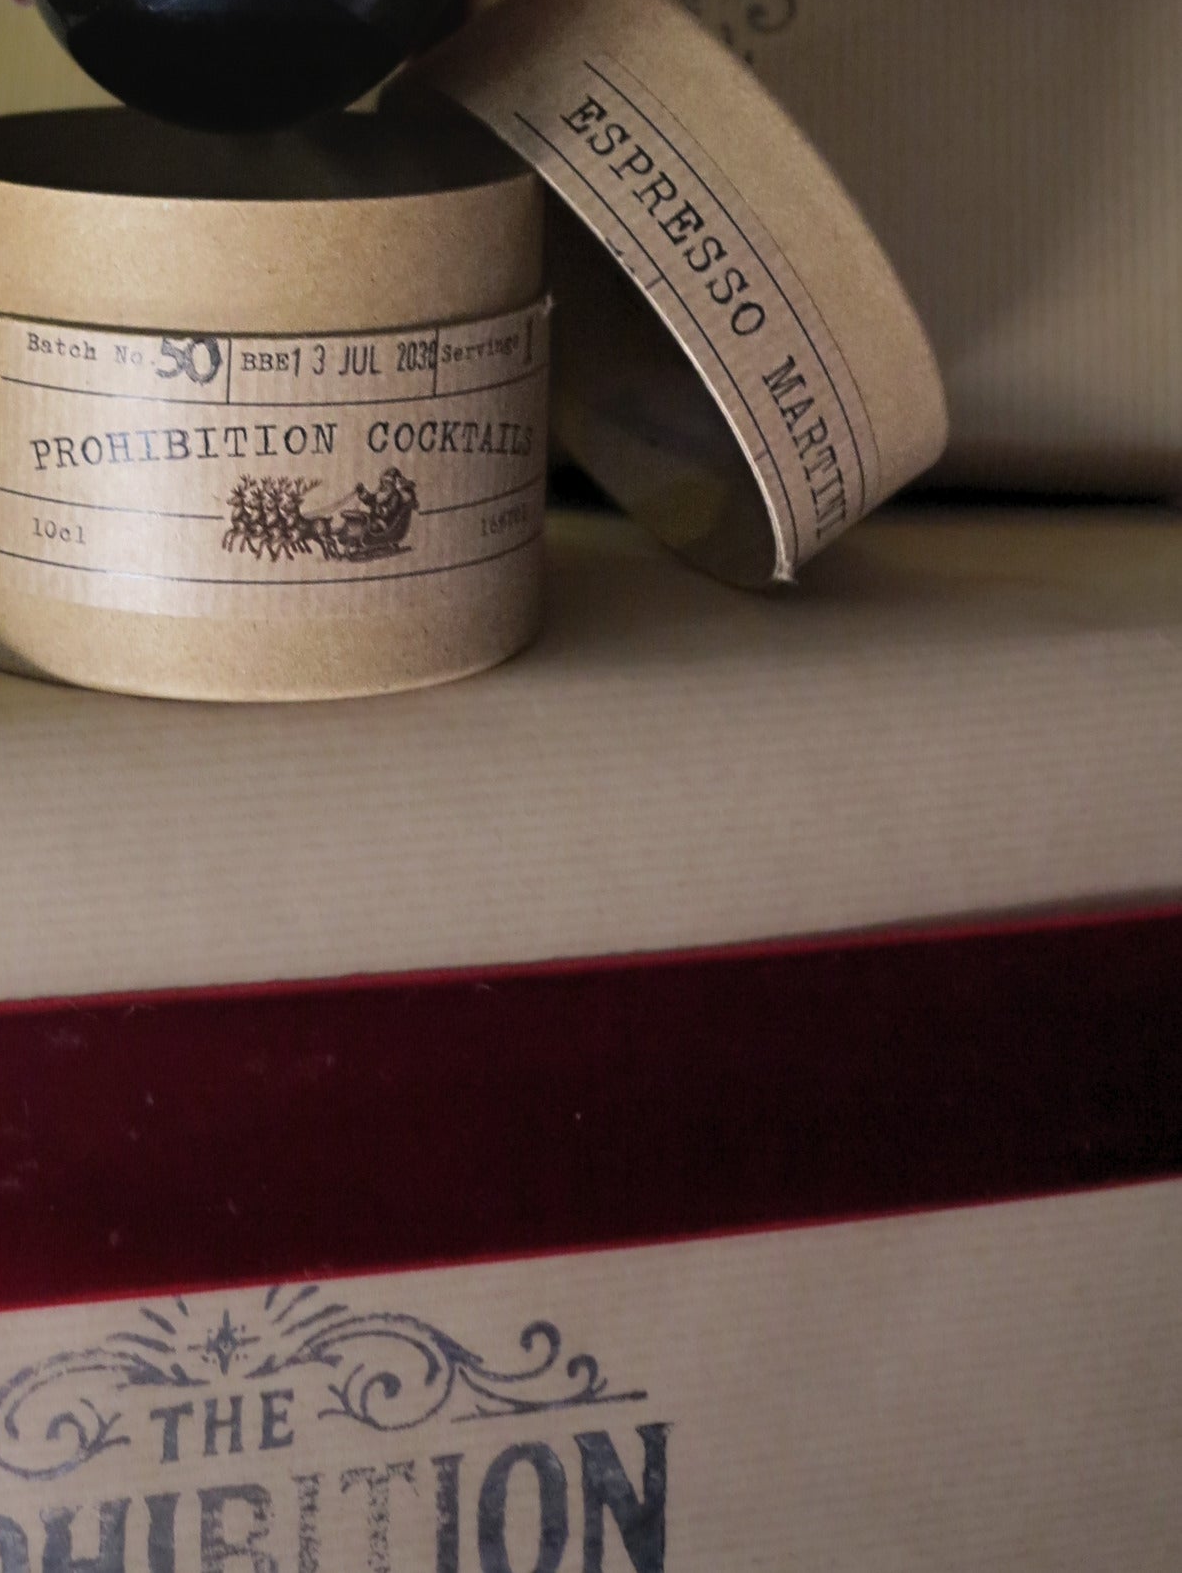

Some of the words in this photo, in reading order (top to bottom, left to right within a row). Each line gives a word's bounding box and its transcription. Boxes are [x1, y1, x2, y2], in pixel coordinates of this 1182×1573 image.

[559, 93, 766, 337] ESPRESSO
[26, 331, 98, 362] Batch
[154, 335, 224, 387] 50
[240, 351, 290, 372] BBE
[337, 344, 382, 376] JUL
[29, 422, 338, 471] PROHIBITION
[367, 420, 534, 457] COCKTAILS
[31, 517, 87, 546] 10cl
[149, 1388, 296, 1465] THE
